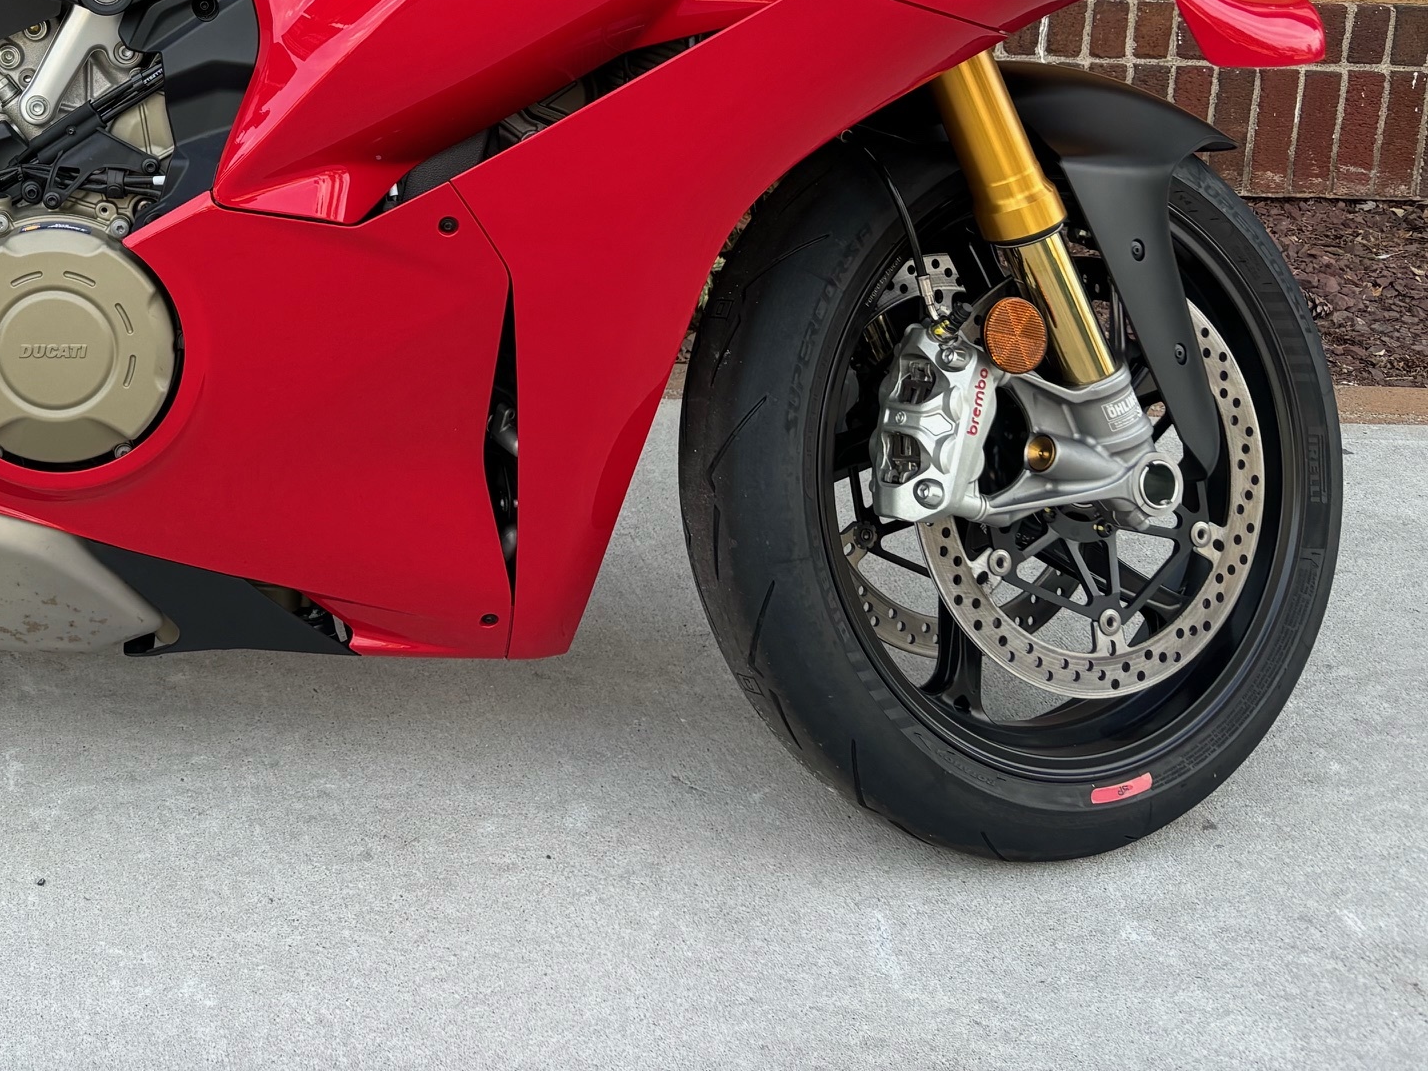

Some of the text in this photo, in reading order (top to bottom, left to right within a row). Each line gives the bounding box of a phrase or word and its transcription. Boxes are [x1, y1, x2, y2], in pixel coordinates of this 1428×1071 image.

[18, 343, 87, 359] DUCATI
[966, 367, 989, 436] brembo
[1306, 426, 1328, 504] PIRELLI
